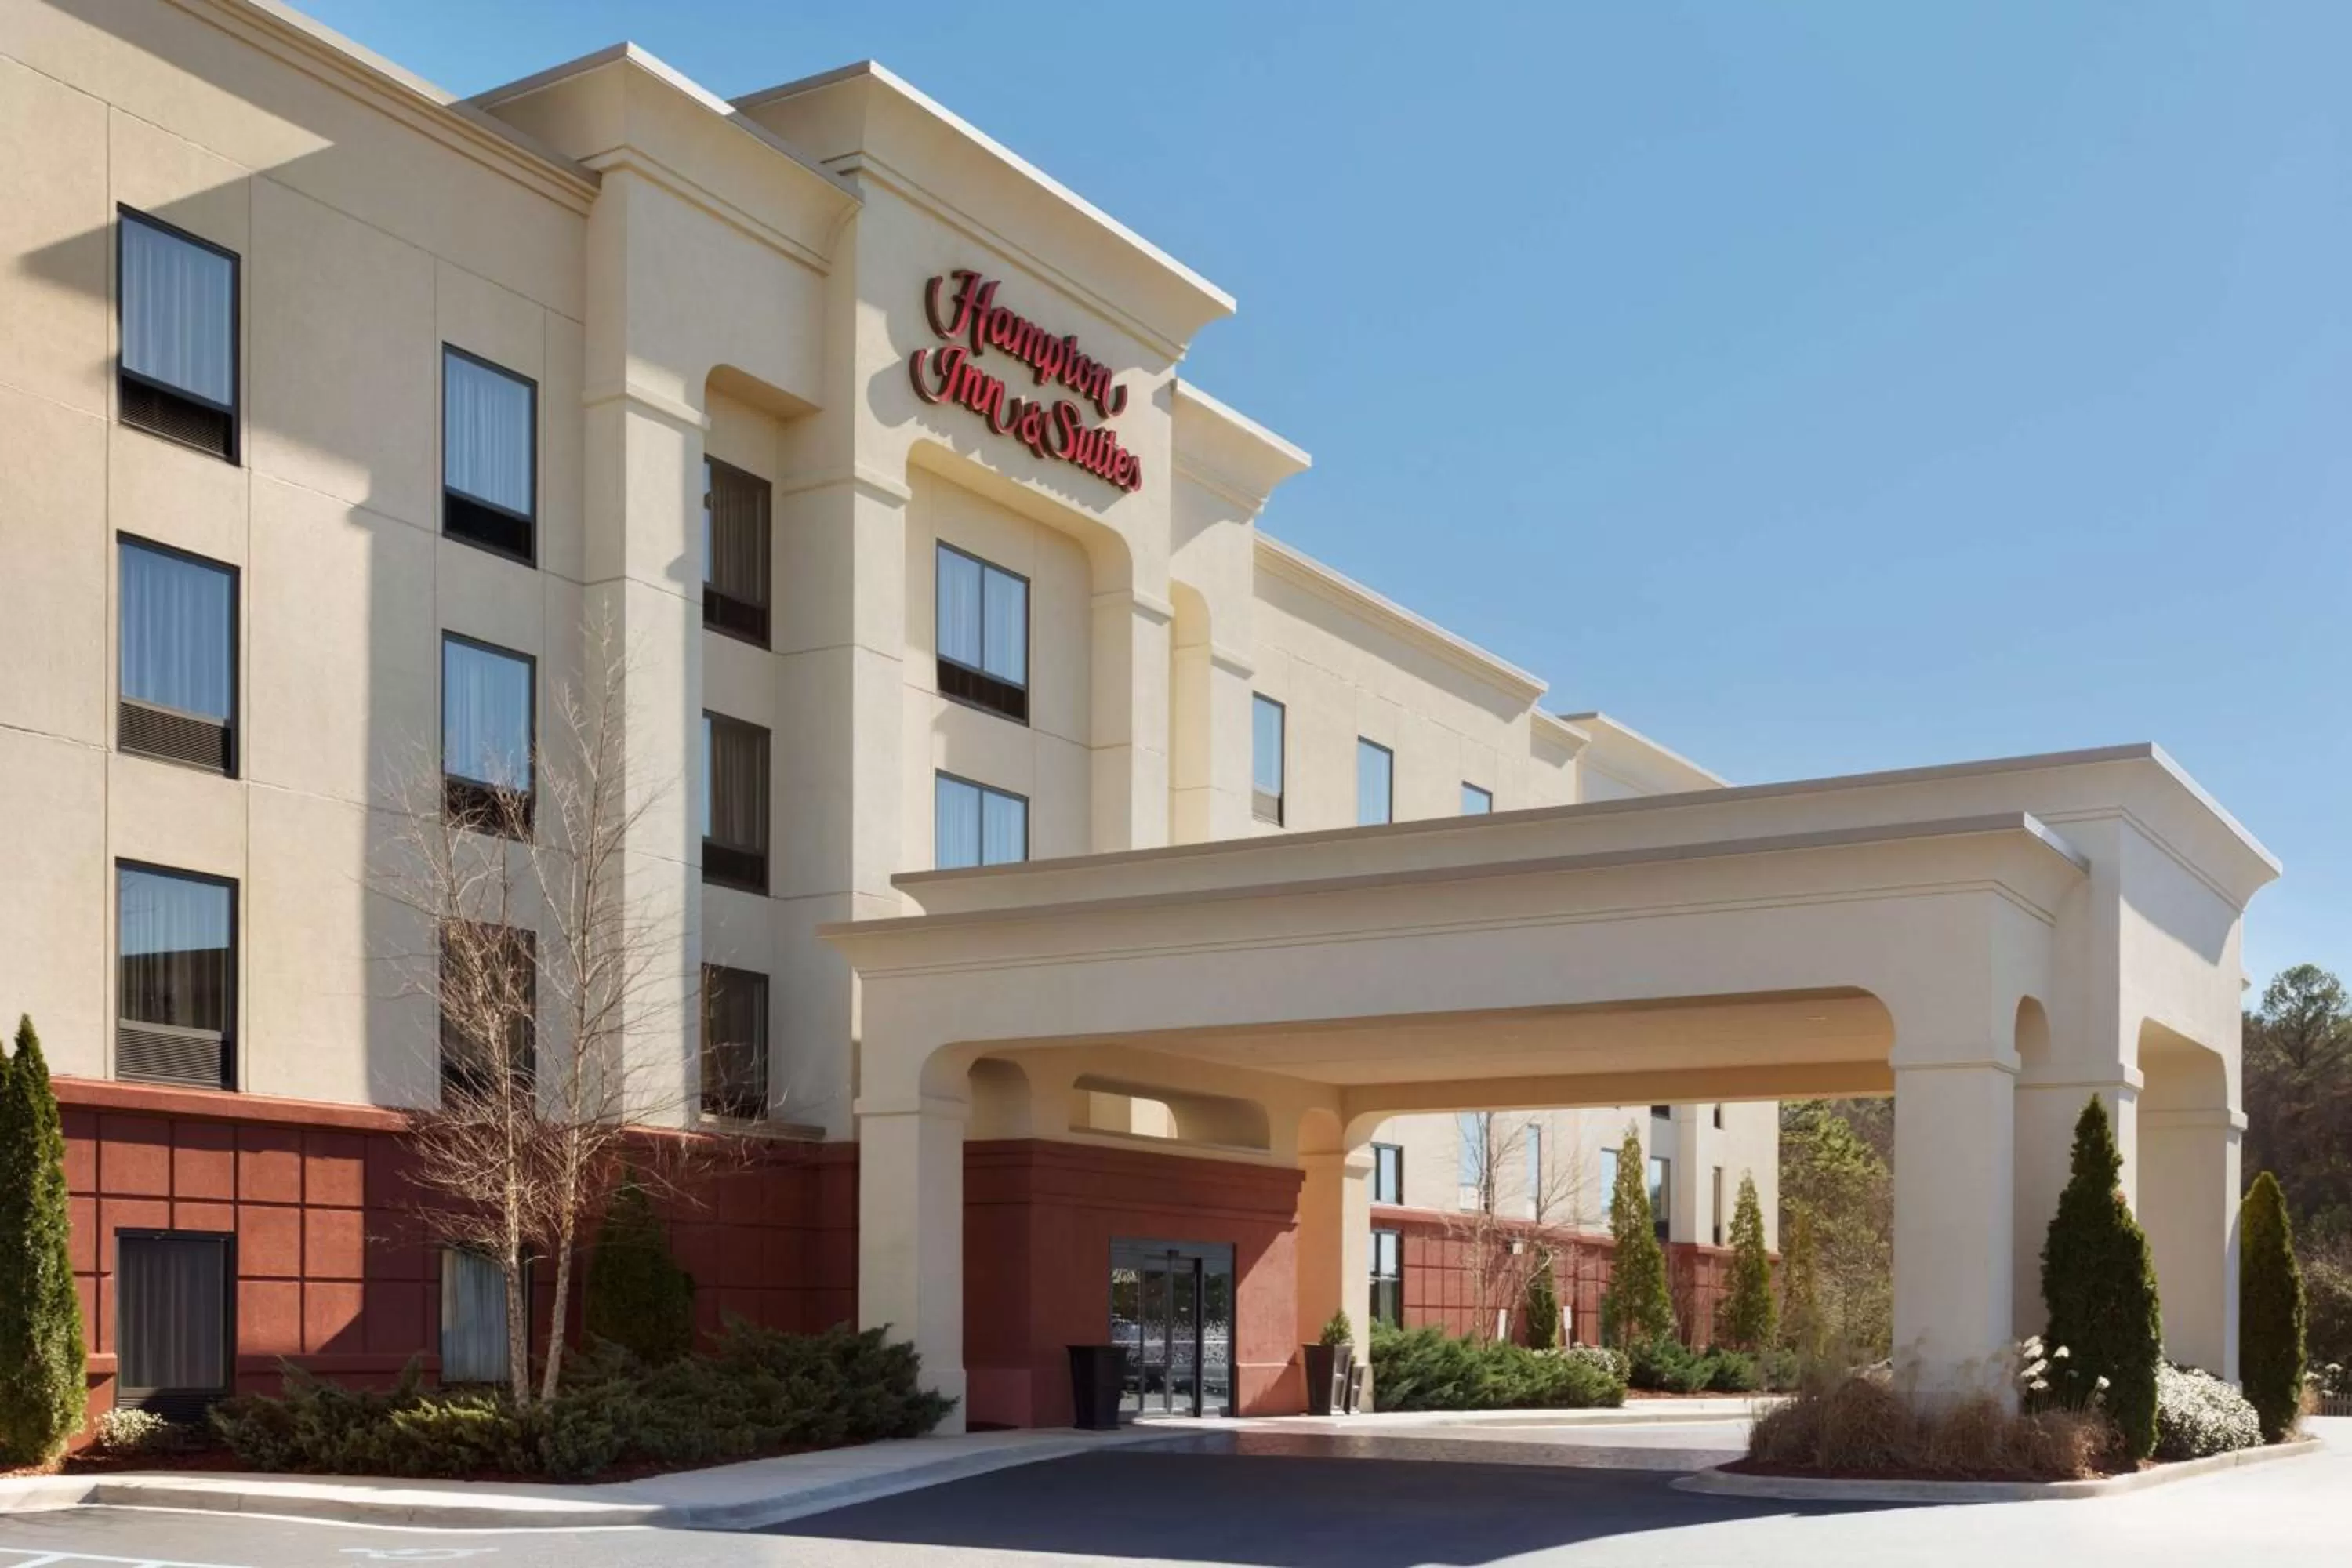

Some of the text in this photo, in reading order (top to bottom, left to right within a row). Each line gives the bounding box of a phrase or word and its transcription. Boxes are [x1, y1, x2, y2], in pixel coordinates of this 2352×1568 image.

[925, 270, 1127, 418] Hampton
[909, 345, 1142, 492] Inn & Suites
